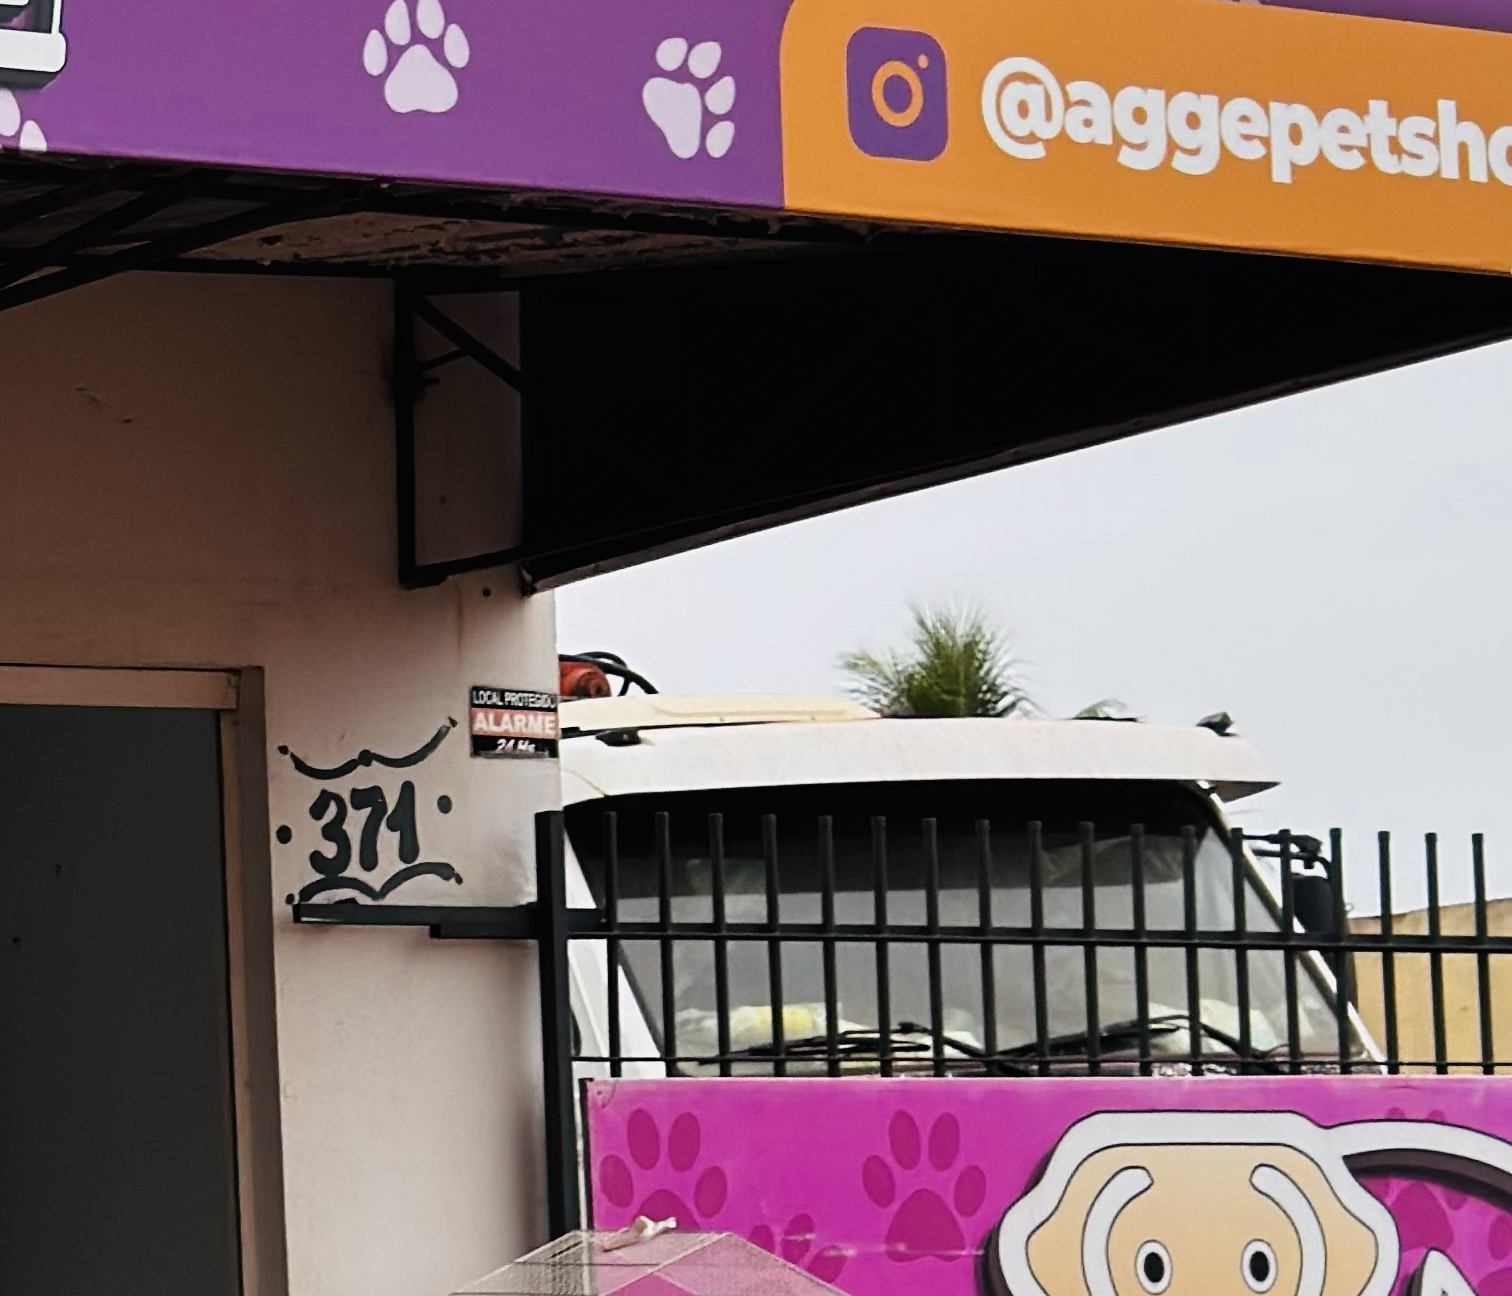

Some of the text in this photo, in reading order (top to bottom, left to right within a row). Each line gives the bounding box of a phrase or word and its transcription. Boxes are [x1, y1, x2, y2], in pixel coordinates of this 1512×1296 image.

[472, 690, 503, 706] LOCAL
[473, 711, 556, 734] ALARME
[496, 738, 516, 754] 24
[309, 780, 420, 877] 371
